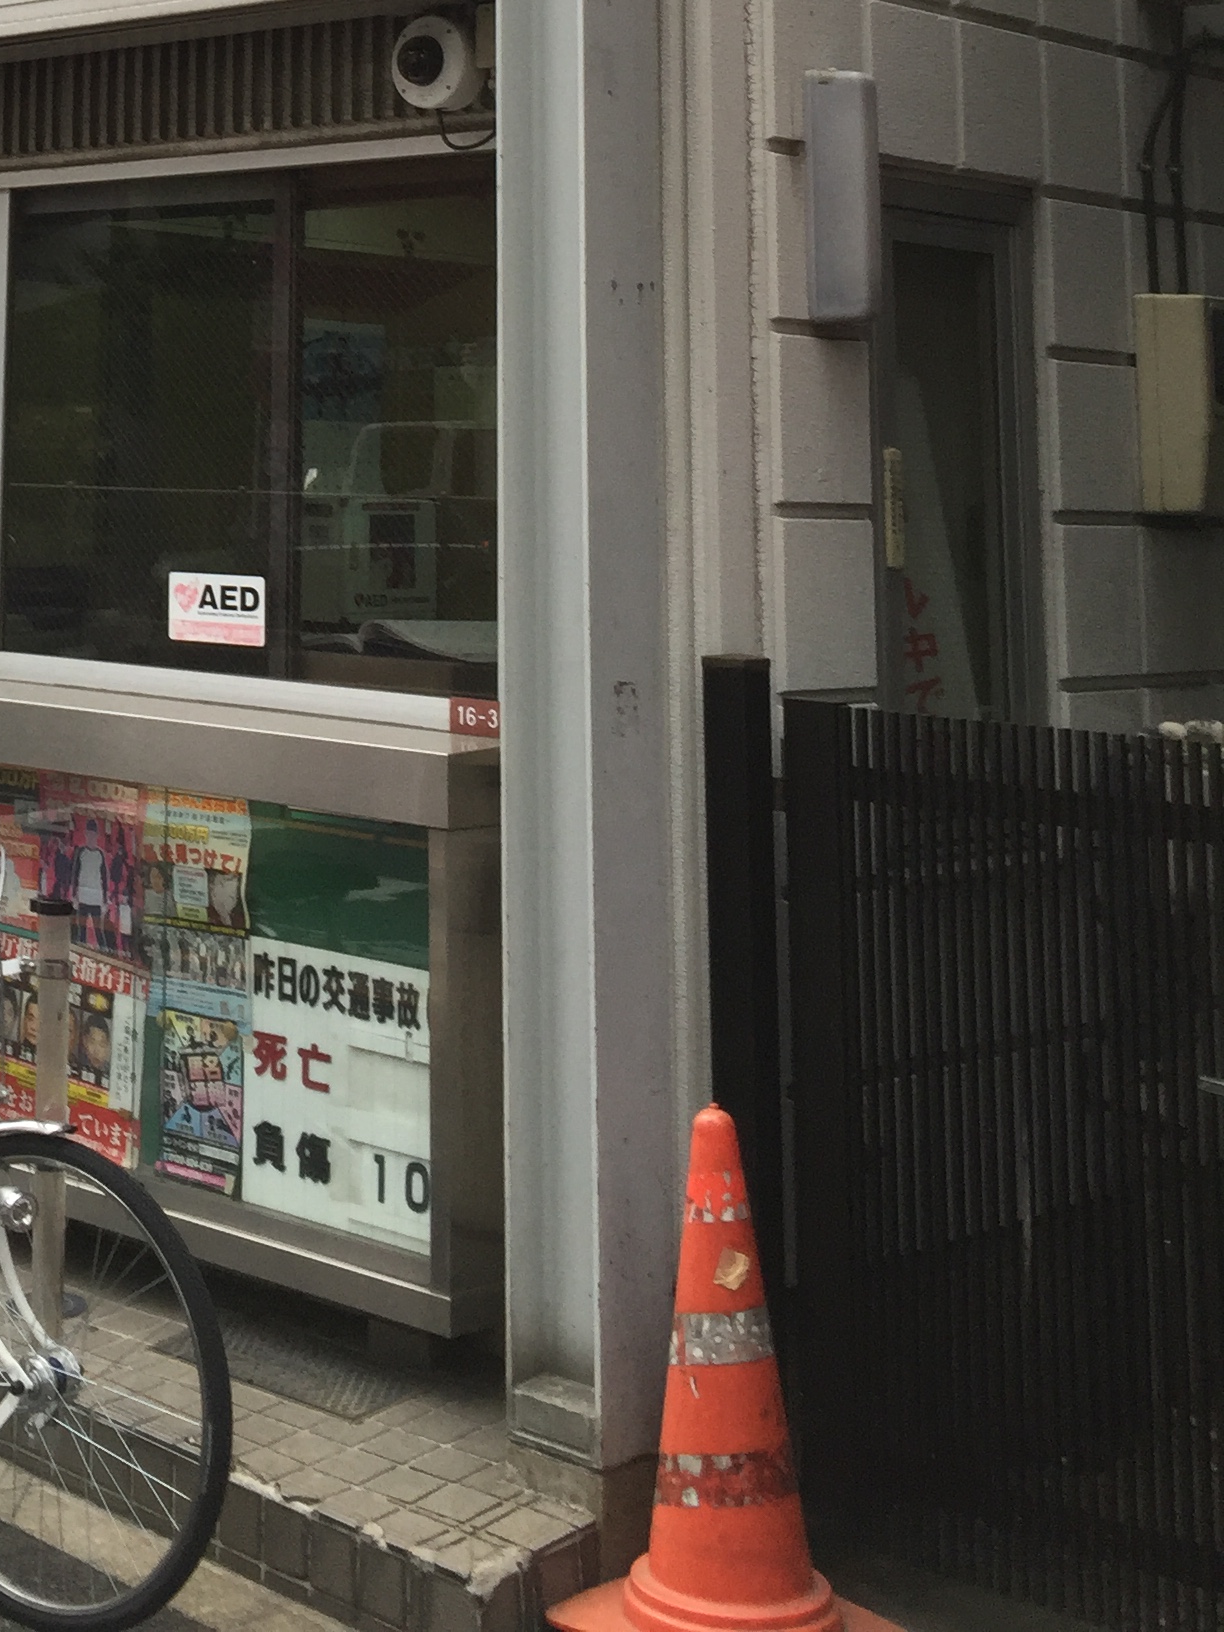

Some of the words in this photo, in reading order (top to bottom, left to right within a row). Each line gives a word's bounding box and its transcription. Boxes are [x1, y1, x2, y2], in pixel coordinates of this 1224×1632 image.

[199, 584, 260, 611] AED
[457, 705, 498, 729] 16-3
[253, 951, 422, 1030] 昨日の交通事故
[252, 1030, 332, 1094] 死亡
[252, 1120, 332, 1186] 負傷
[373, 1153, 431, 1214] 10
